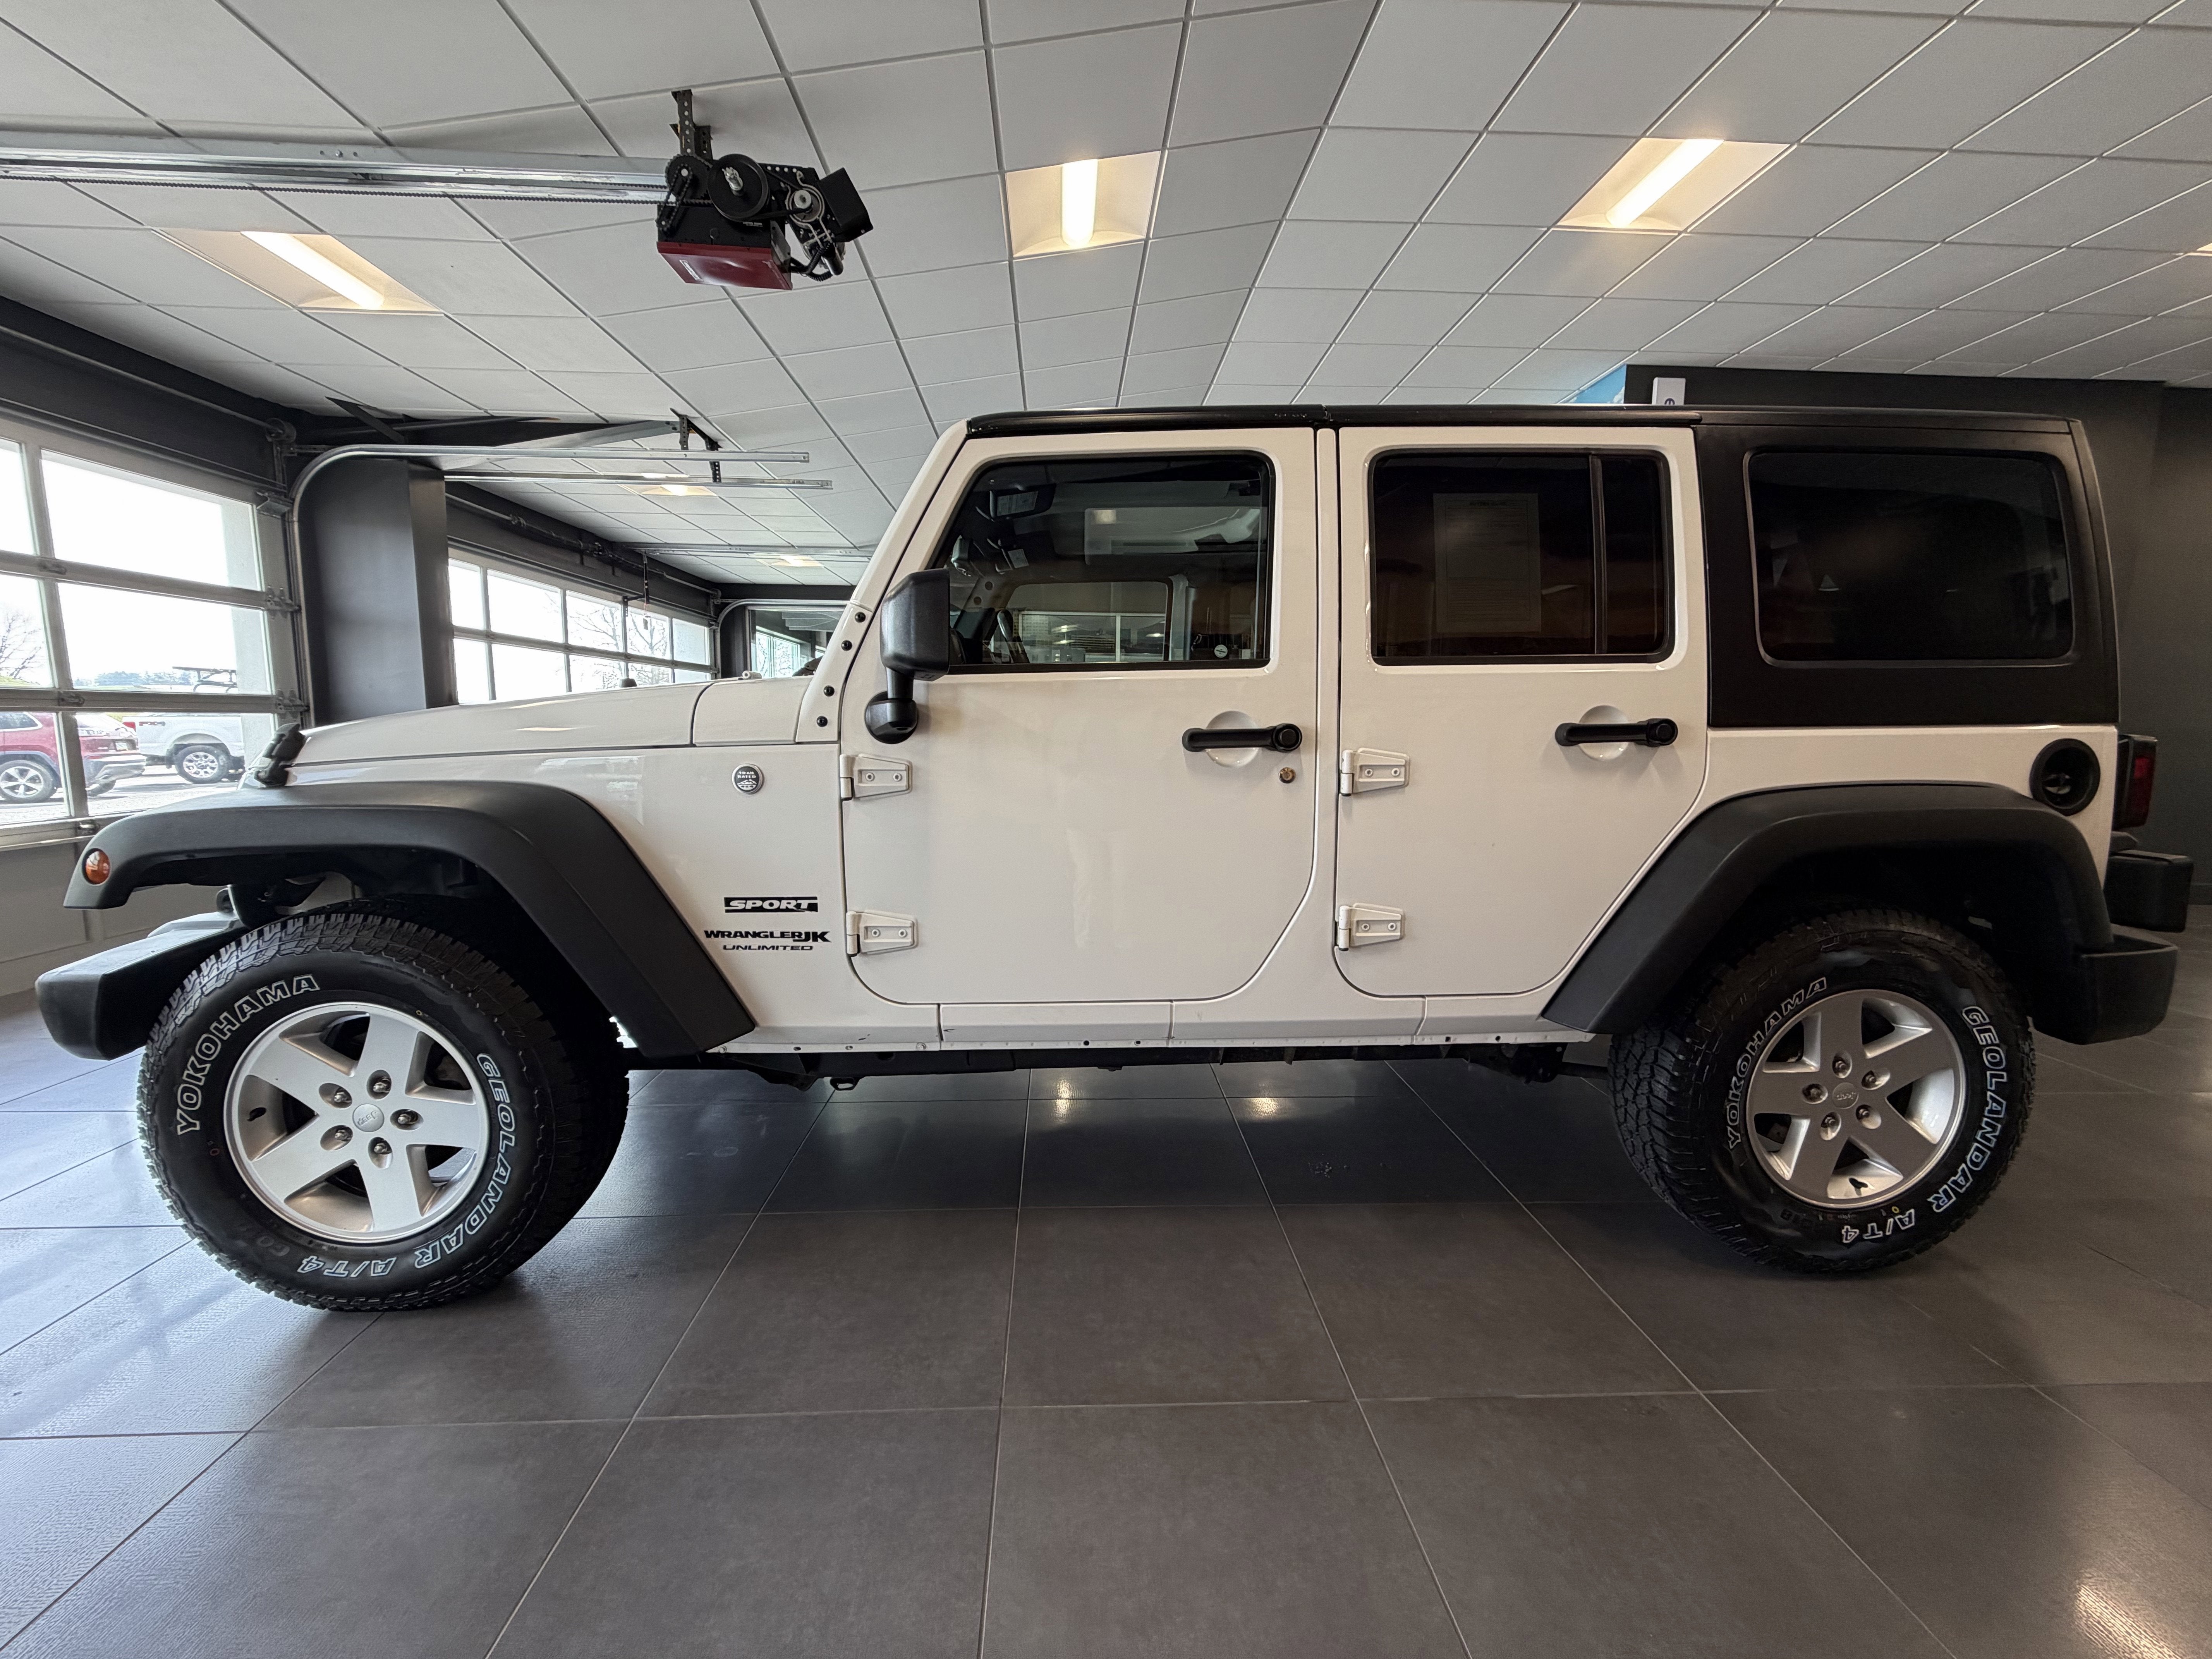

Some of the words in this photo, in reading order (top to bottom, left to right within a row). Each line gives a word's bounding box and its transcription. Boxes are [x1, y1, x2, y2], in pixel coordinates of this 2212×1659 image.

[725, 899, 817, 910] SPORT
[177, 974, 320, 1135] YOKOHAMA
[1726, 977, 1827, 1149] YOKOHAMA
[357, 1110, 378, 1126] Jeep
[1927, 1006, 2008, 1214] GEOLANDAR
[414, 1053, 515, 1269] GEOLANDAR
[297, 1255, 396, 1278] A/T4
[1841, 1209, 1915, 1243] A/T4
